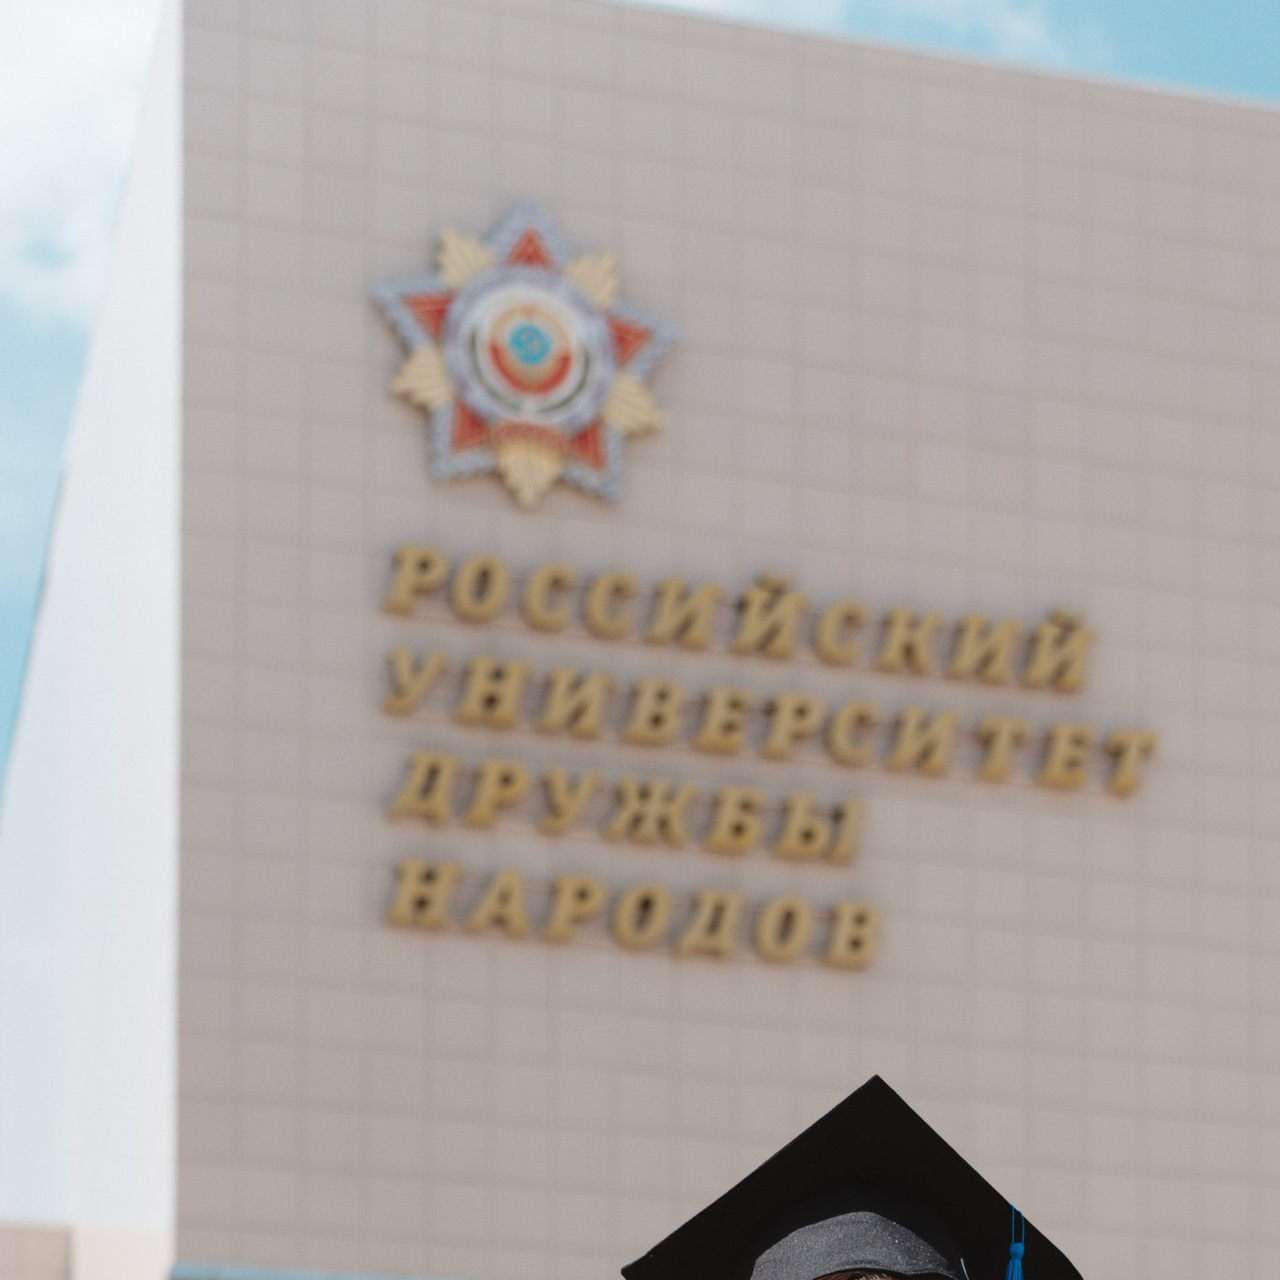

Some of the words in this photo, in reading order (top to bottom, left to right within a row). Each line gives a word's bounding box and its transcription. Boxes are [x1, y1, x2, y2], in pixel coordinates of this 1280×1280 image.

[384, 545, 1097, 696] РОССИЙСКИЙ
[383, 648, 1158, 799] УНИВЕРСИТЕТ
[388, 750, 866, 869] ДРУЖБЫ
[386, 857, 882, 972] НАРОДОВ
